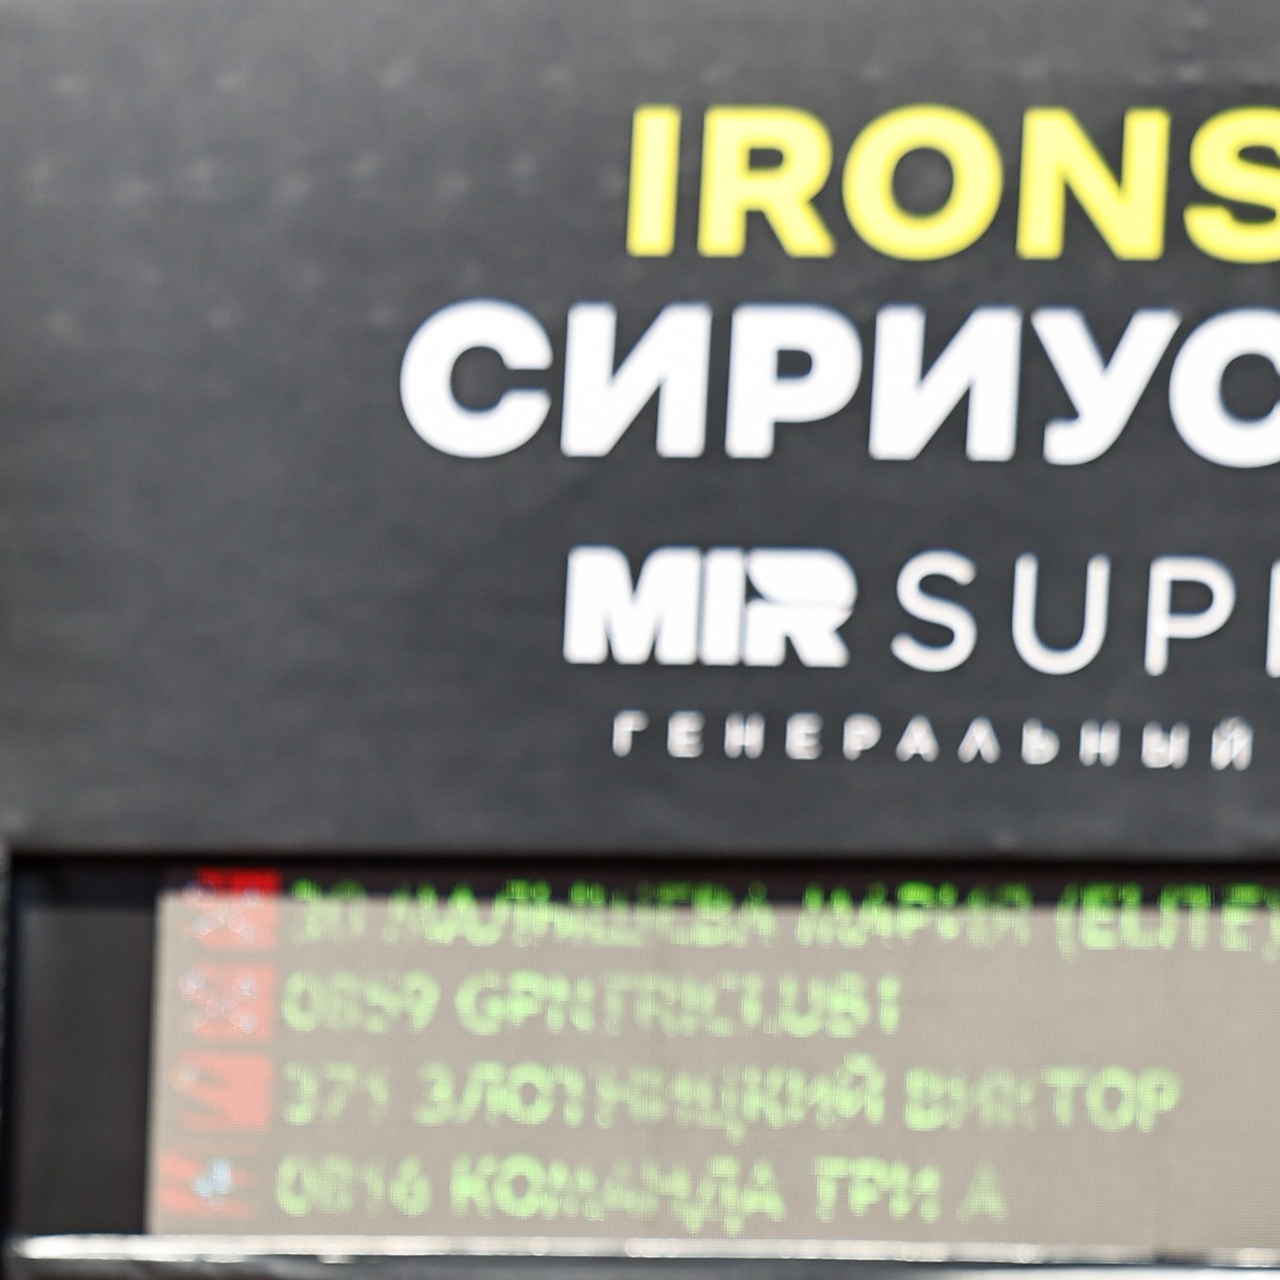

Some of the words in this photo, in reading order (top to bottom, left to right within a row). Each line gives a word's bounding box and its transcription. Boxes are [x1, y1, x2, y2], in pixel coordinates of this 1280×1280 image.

[399, 297, 1280, 468] СИРИУС
[563, 545, 858, 668] MIR
[890, 550, 1280, 676] SUP
[611, 709, 1254, 770] ГЕНЕРАЛЬНЫЙ
